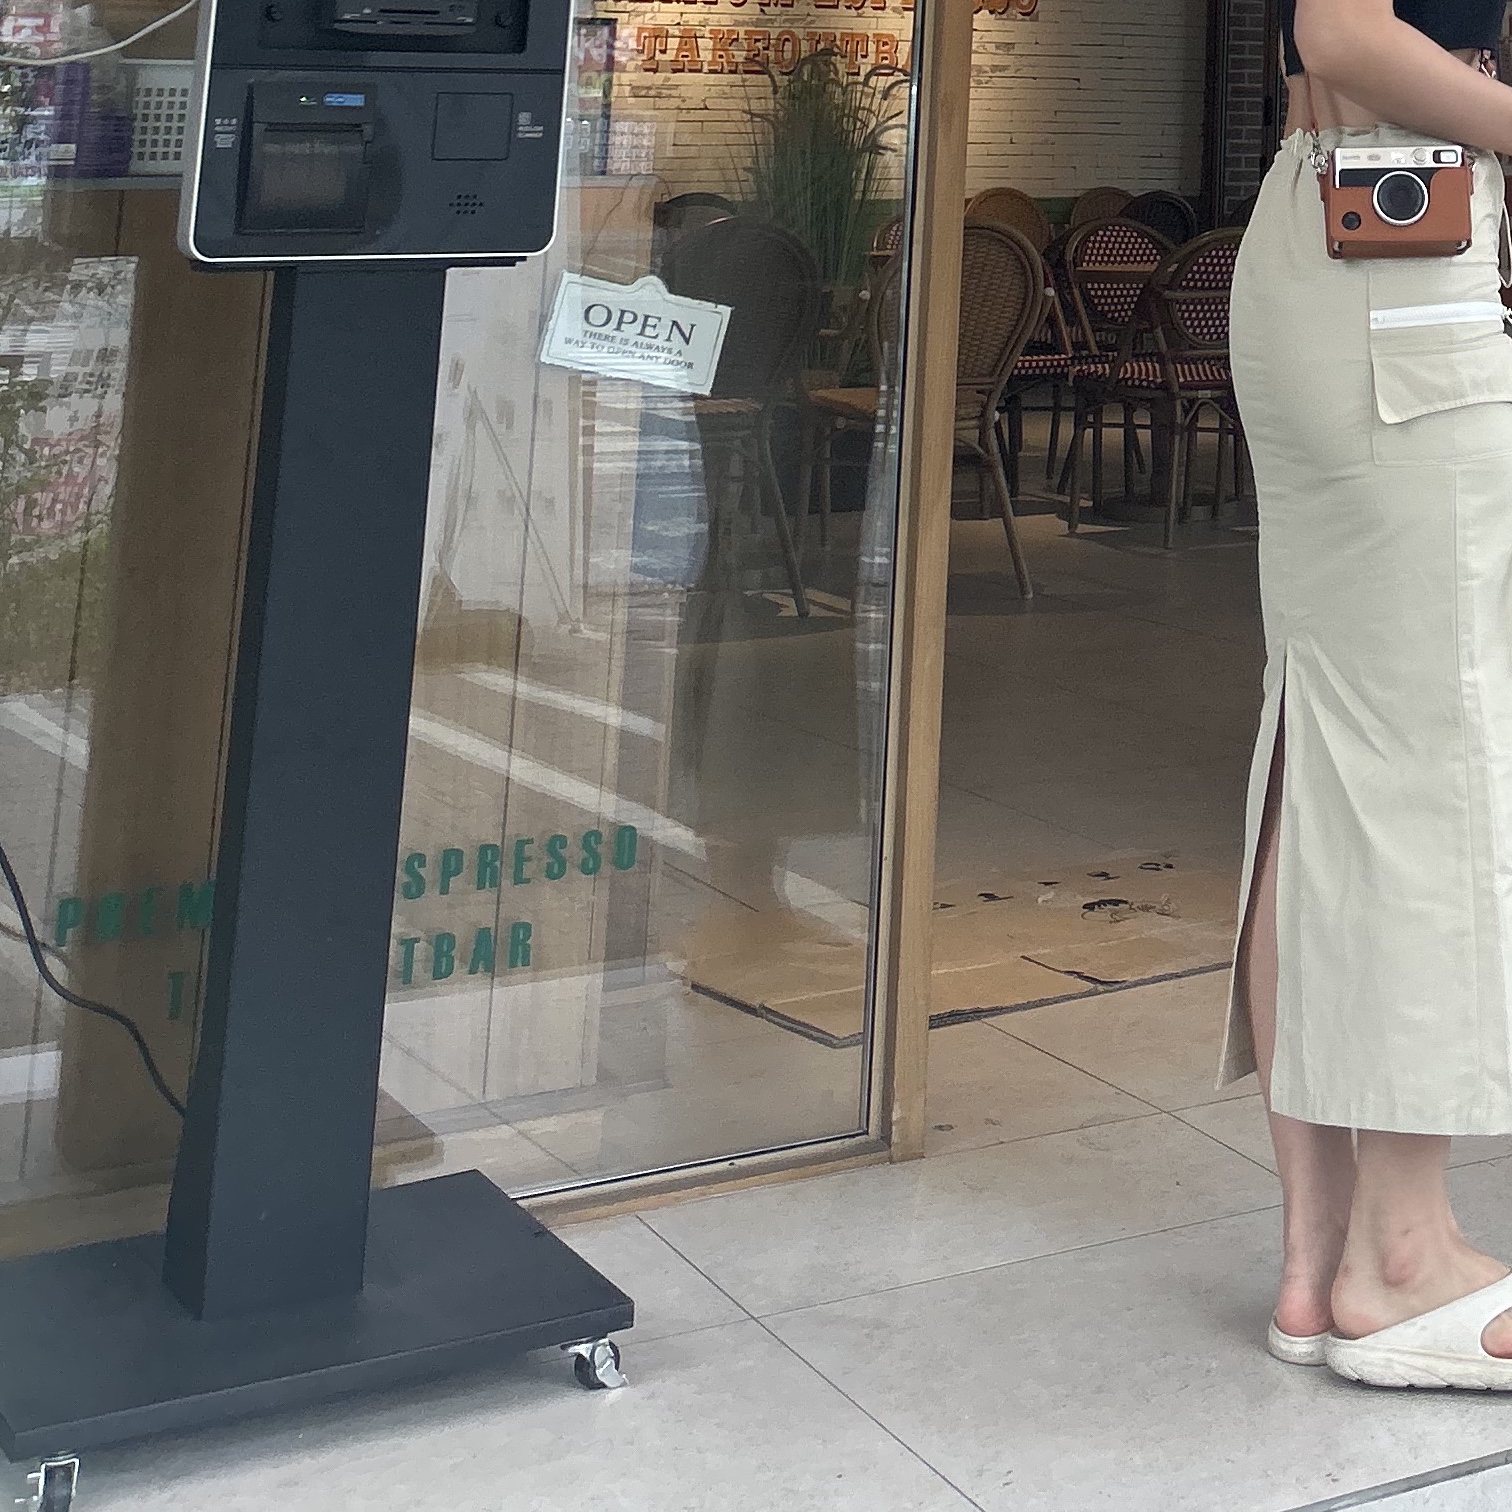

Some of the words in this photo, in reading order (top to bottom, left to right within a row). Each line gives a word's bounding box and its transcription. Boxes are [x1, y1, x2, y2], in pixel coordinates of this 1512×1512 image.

[584, 303, 696, 346] OPEN
[564, 337, 585, 348] WAY
[589, 341, 603, 352] TO
[582, 330, 617, 344] THERE
[619, 337, 629, 346] IS
[632, 340, 672, 354] ALWAYS
[674, 349, 682, 357] A
[402, 824, 639, 902] SPRESSO
